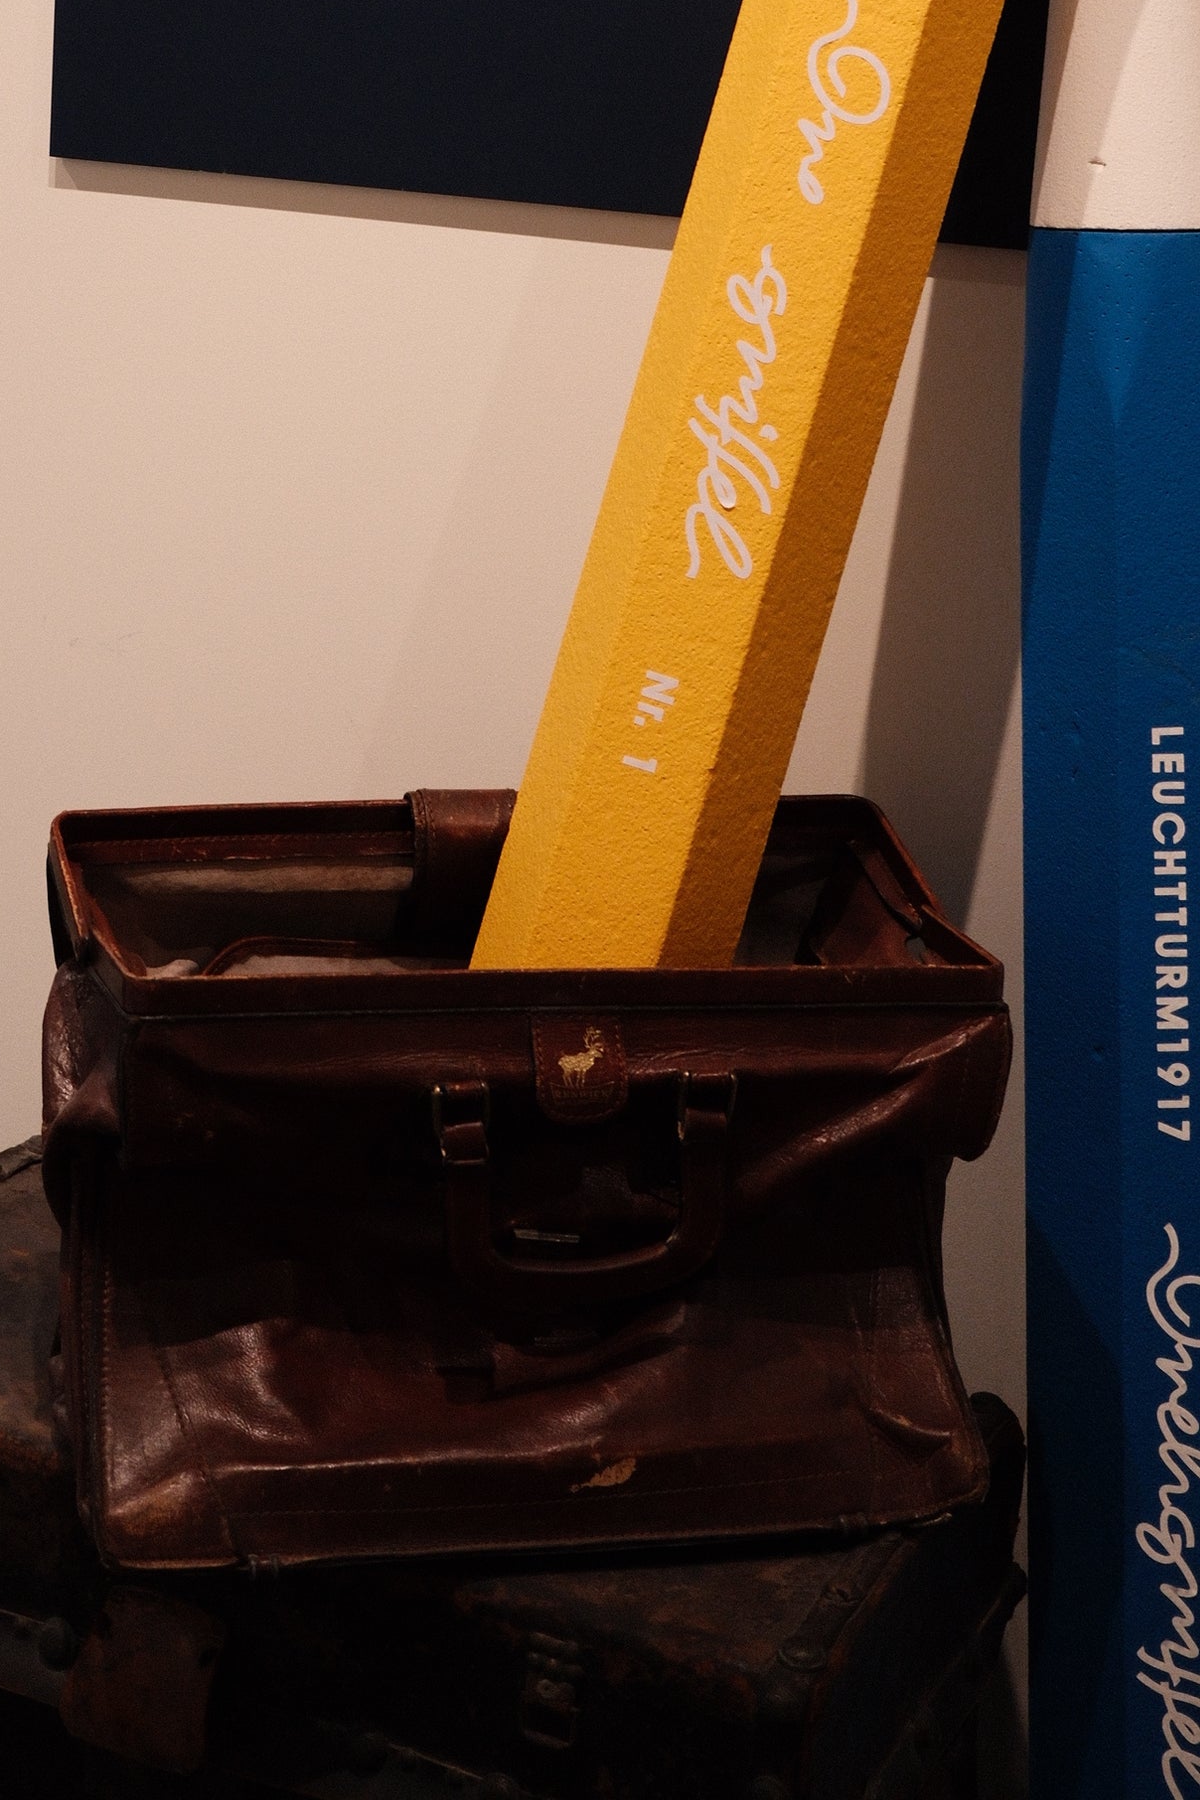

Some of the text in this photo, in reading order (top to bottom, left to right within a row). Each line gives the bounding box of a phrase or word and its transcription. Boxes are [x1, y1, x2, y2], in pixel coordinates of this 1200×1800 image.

[622, 669, 680, 774] Nr. 1
[1151, 726, 1191, 1142] LEUCHTTURM1917
